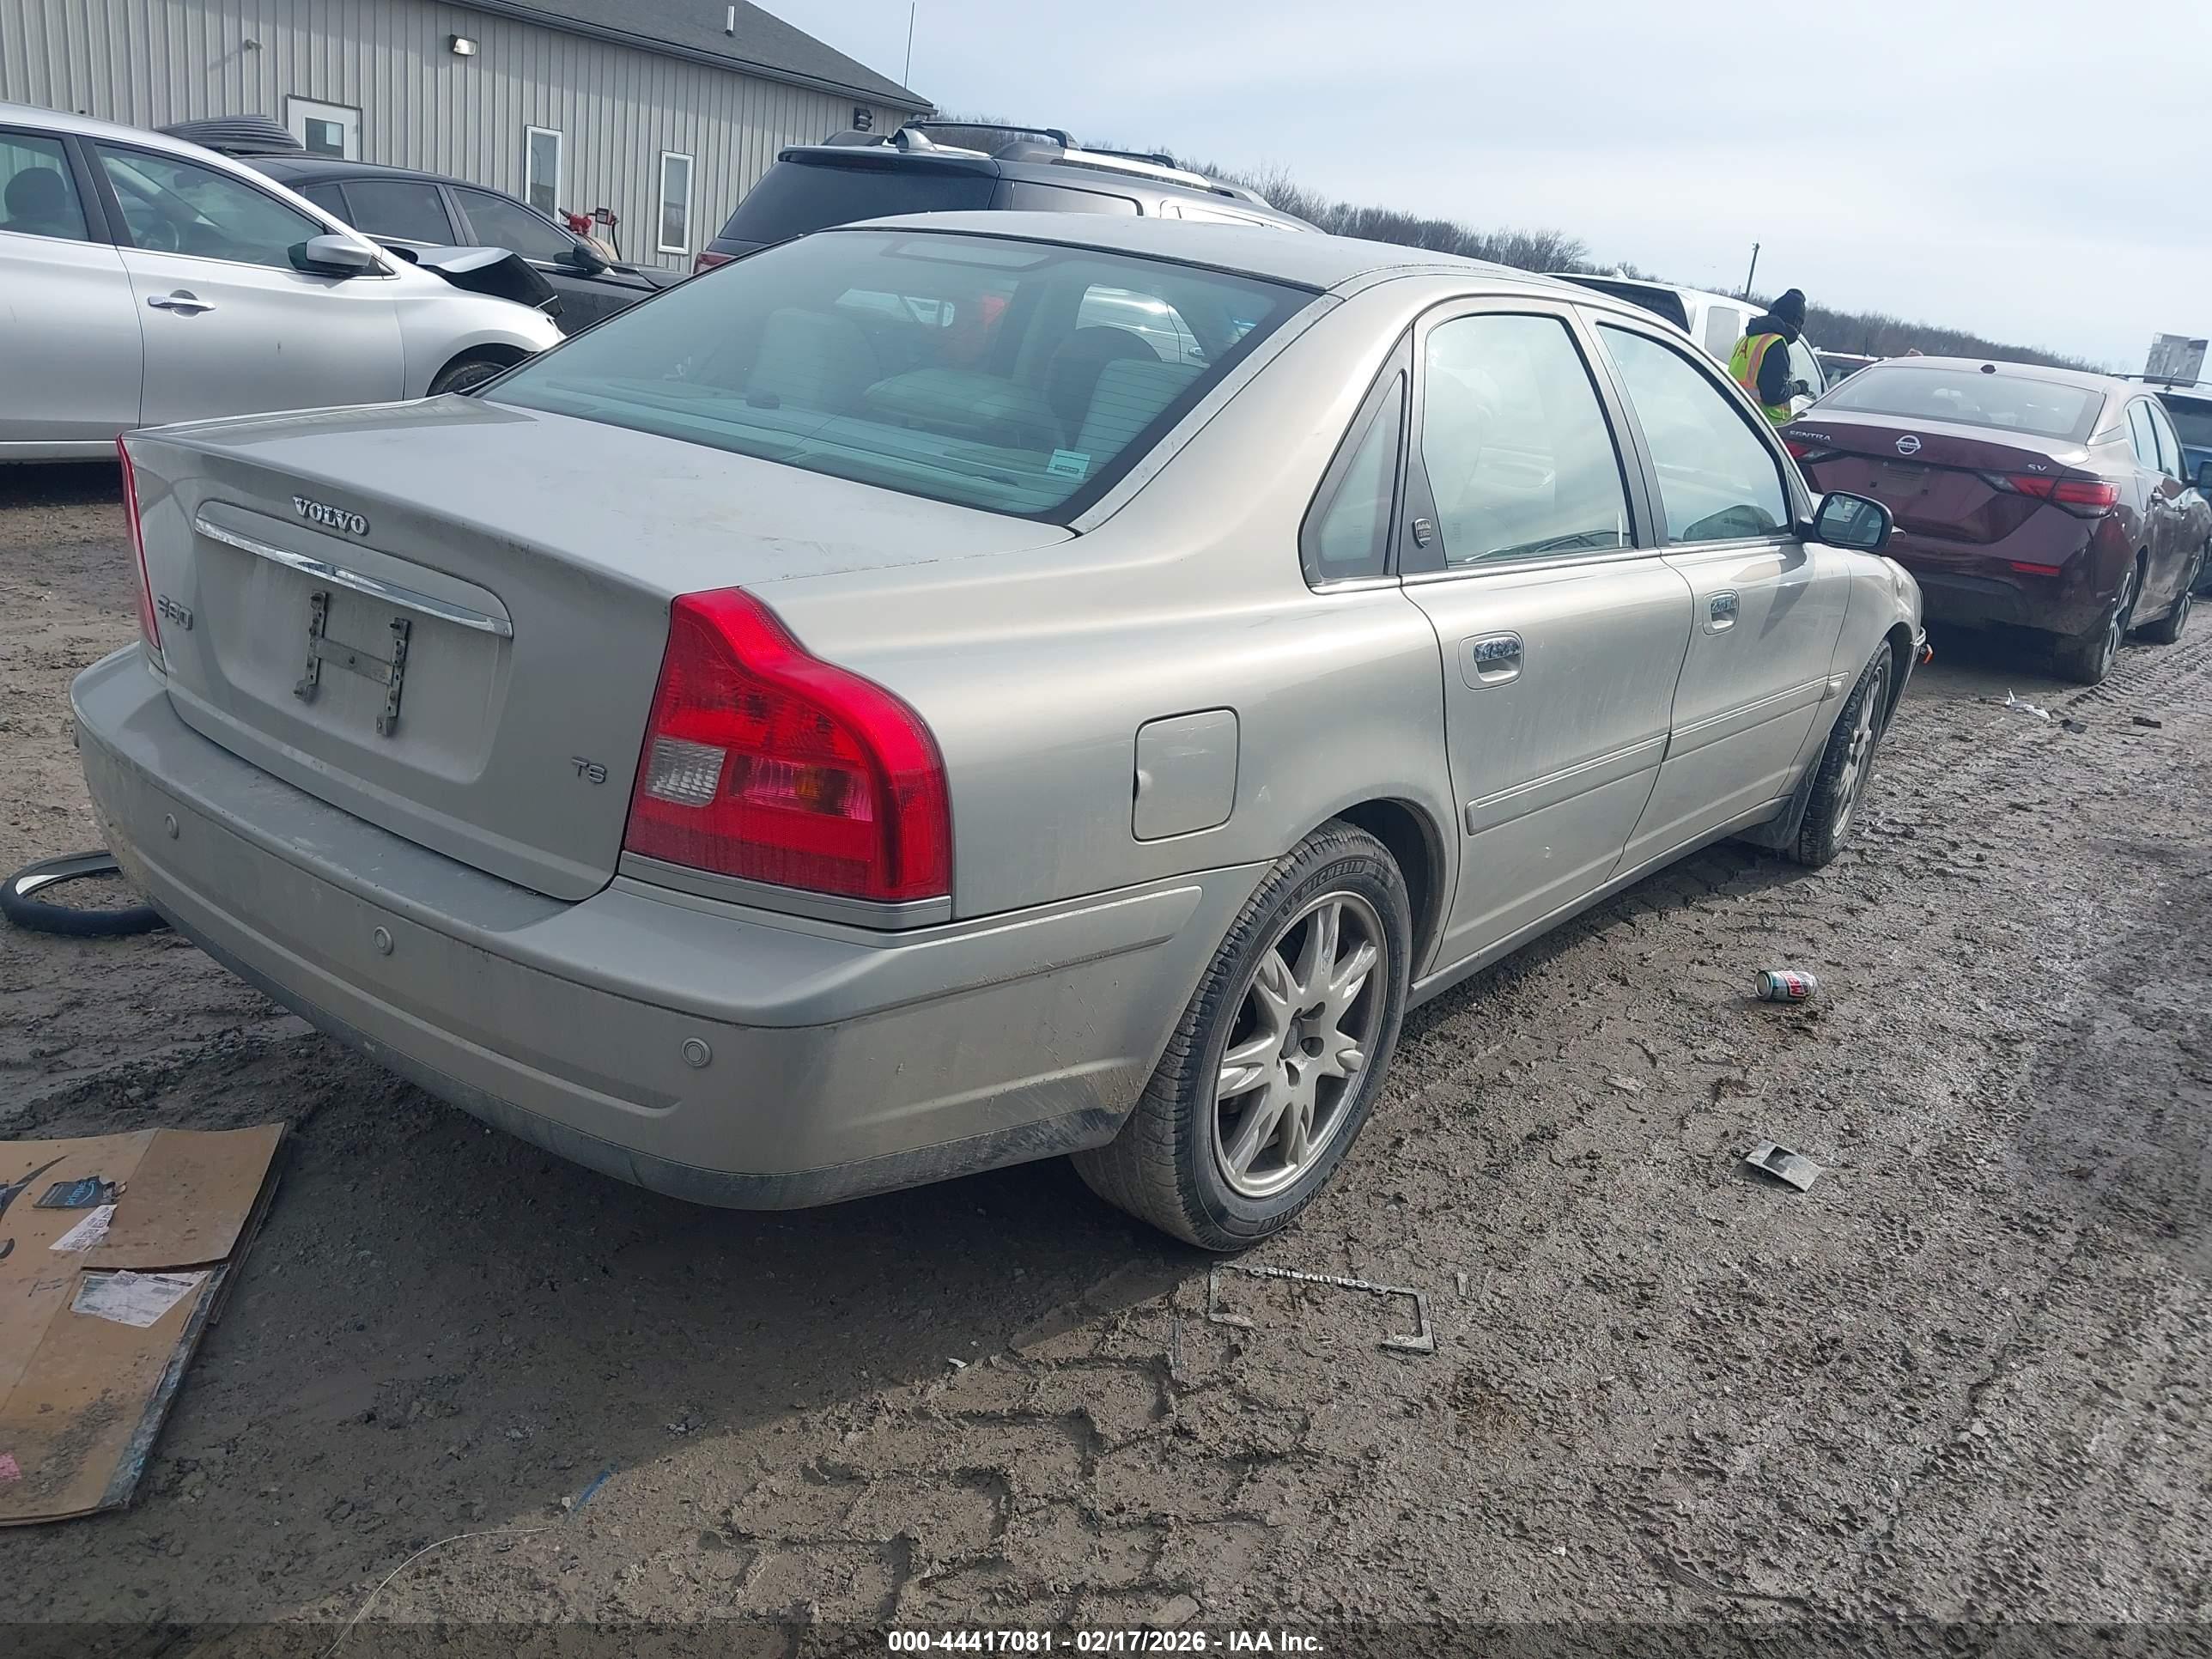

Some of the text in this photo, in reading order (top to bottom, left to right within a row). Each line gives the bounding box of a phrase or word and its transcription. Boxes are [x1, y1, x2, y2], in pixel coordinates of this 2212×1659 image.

[1790, 430, 1832, 441] SENTRA
[292, 495, 368, 536] VOLVO
[1301, 860, 1364, 900] MICHELIN
